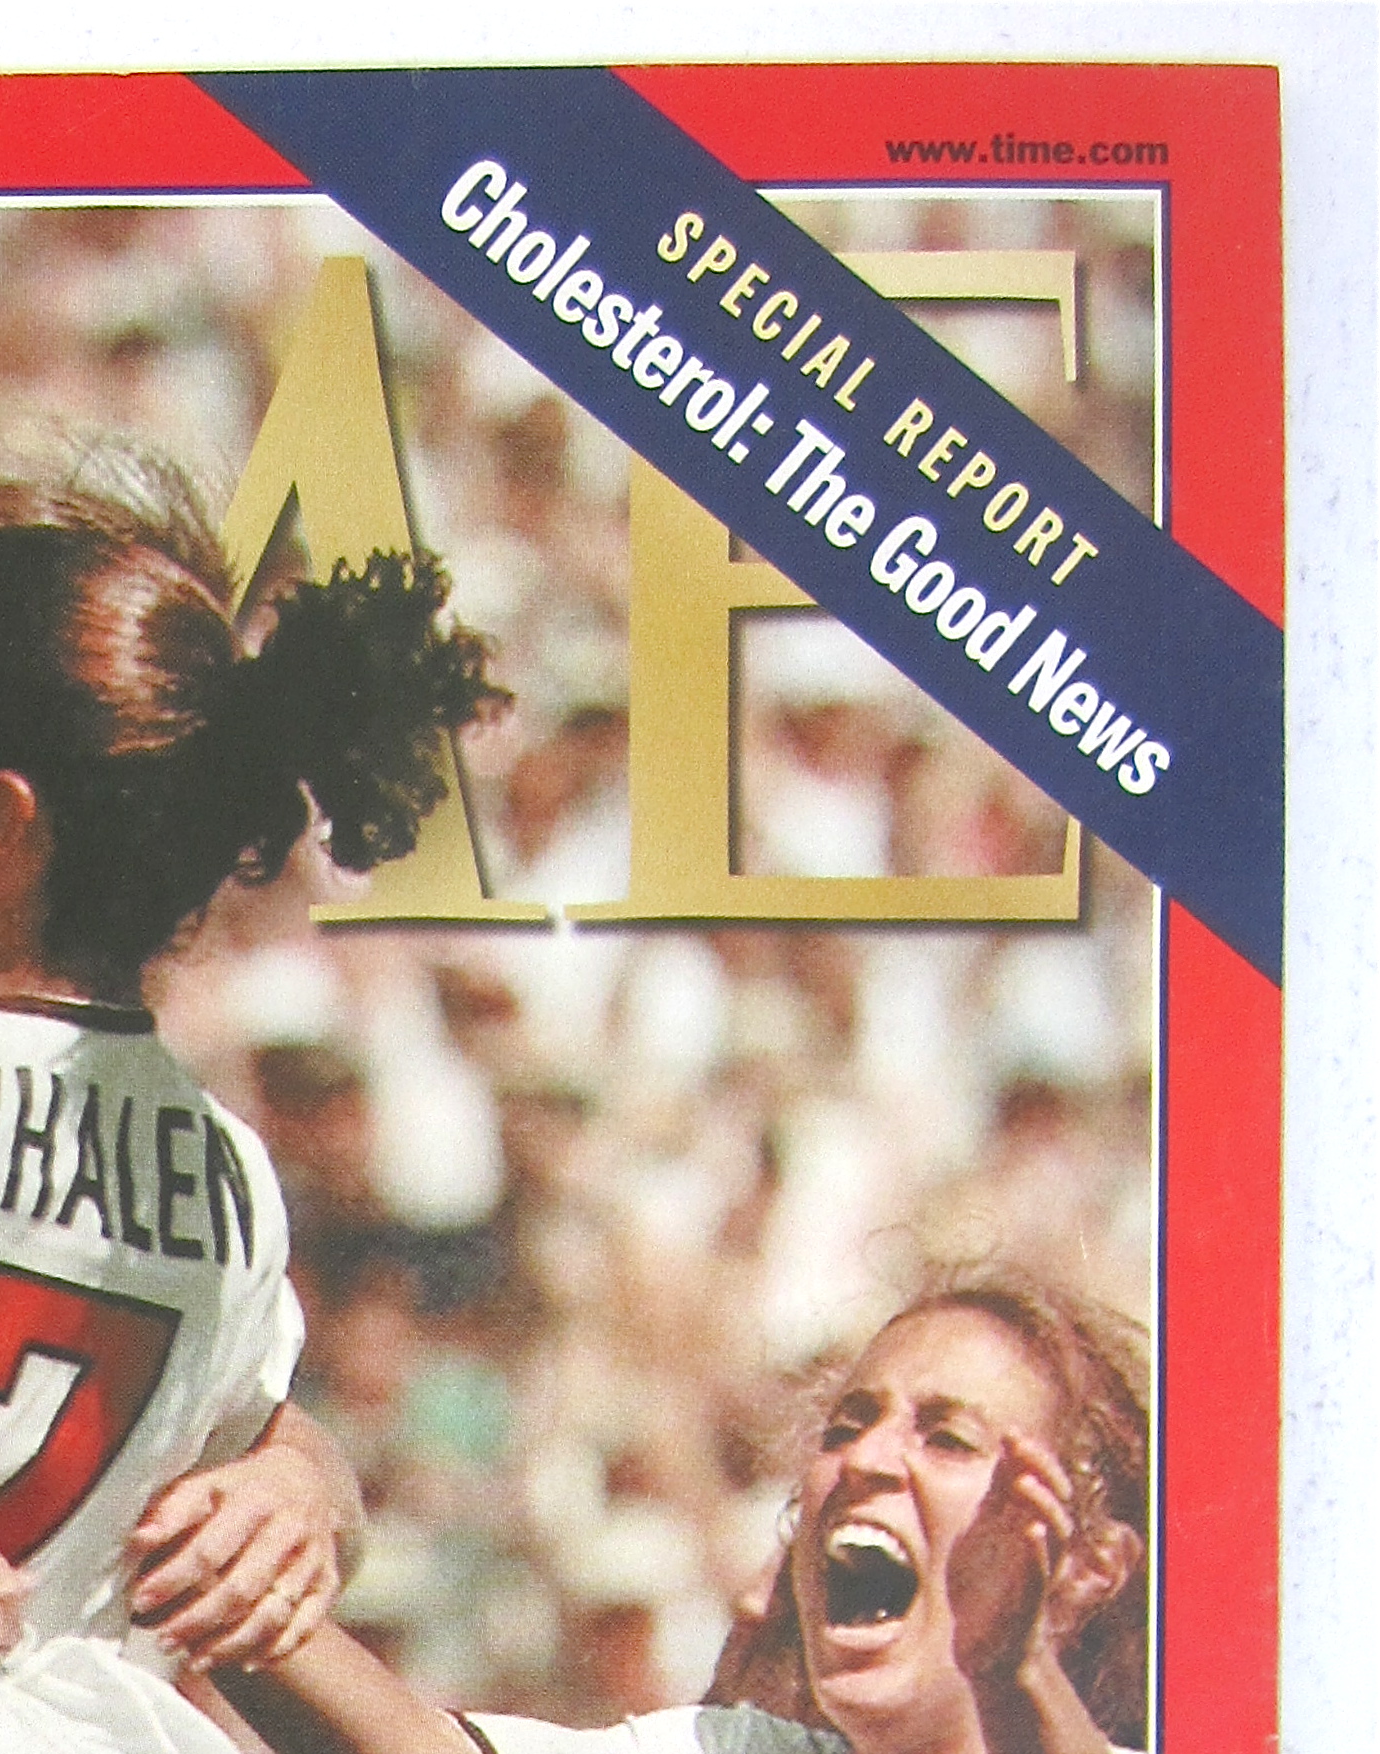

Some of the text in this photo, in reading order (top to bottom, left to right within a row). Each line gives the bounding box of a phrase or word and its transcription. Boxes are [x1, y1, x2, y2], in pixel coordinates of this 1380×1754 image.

[885, 132, 1169, 164] www.time.com
[441, 159, 1171, 795] Cholesterol: The Good News
[658, 211, 1099, 585] SPECIAL REPORT
